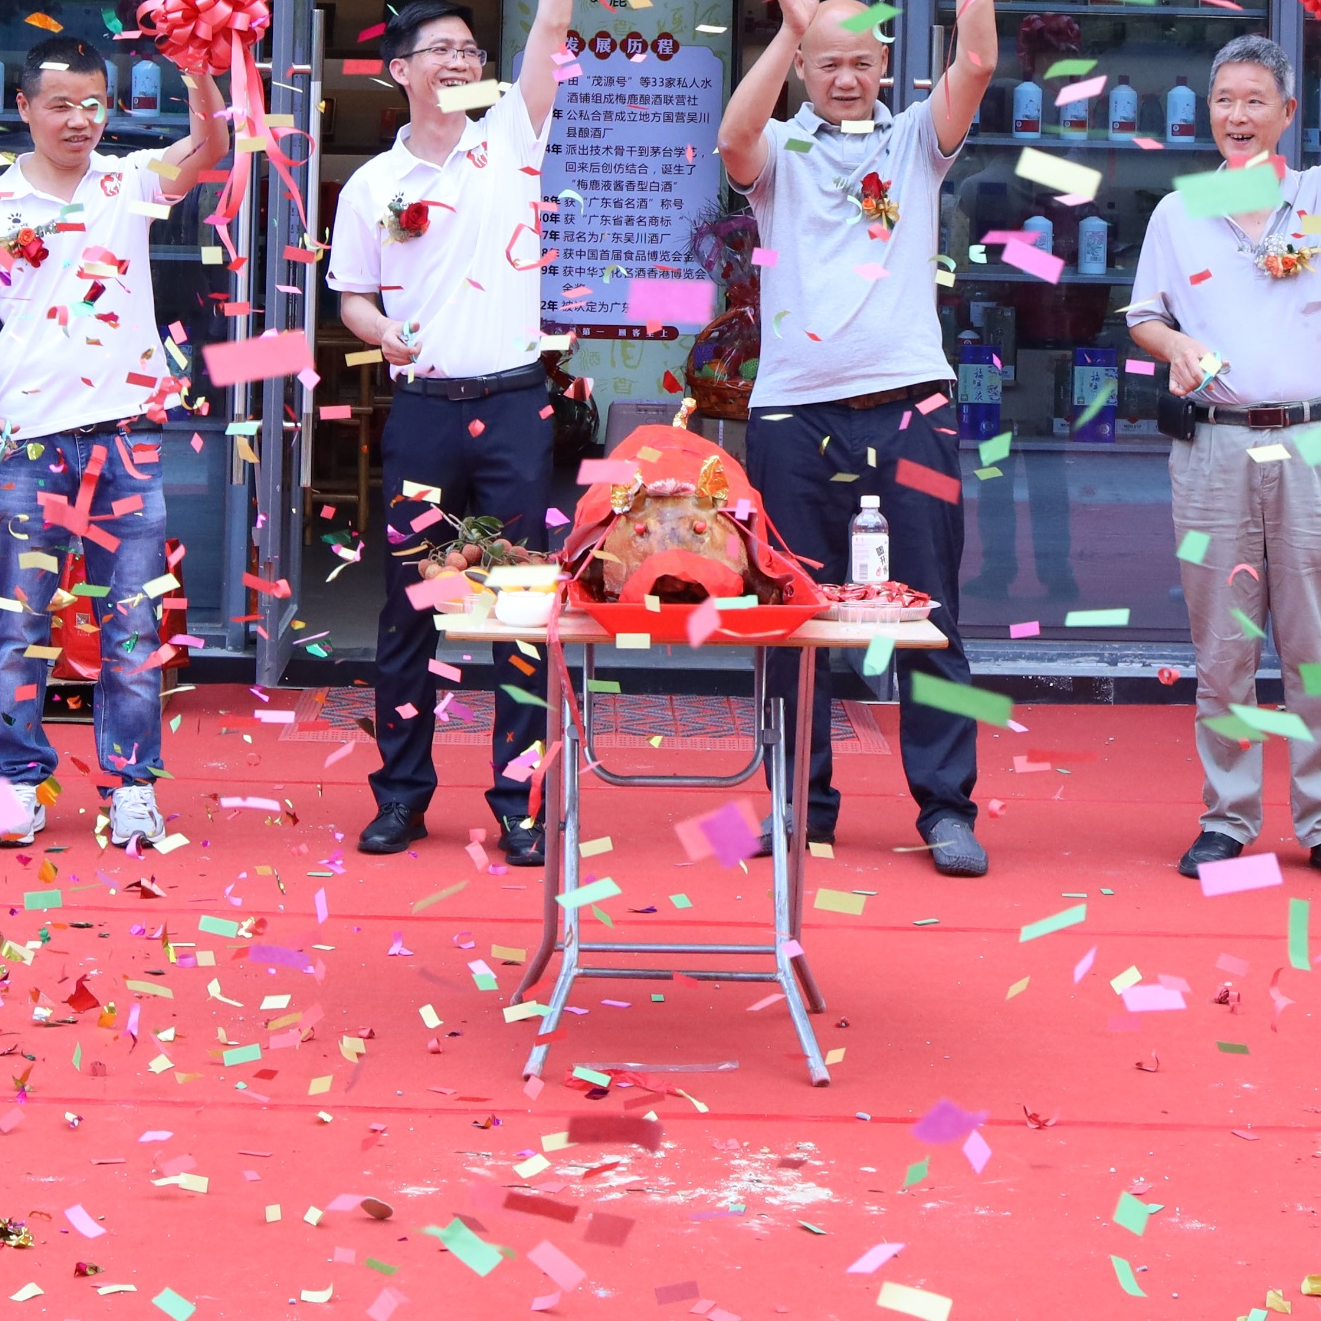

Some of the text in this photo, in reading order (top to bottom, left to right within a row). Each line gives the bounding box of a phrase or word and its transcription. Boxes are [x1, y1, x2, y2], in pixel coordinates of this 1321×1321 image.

[566, 37, 674, 55] 发展历程
[567, 91, 699, 107] 酒铺组成梅鹿酿酒联营社
[567, 110, 710, 124] 公私合营成立地方国营吴川
[566, 127, 613, 139] 县酿酒厂
[565, 162, 696, 176] 回来后创仿结合，诞生了
[563, 231, 671, 244] 冠名为广东吴川酒厂
[563, 249, 694, 262] 获中国首届食品博览会金
